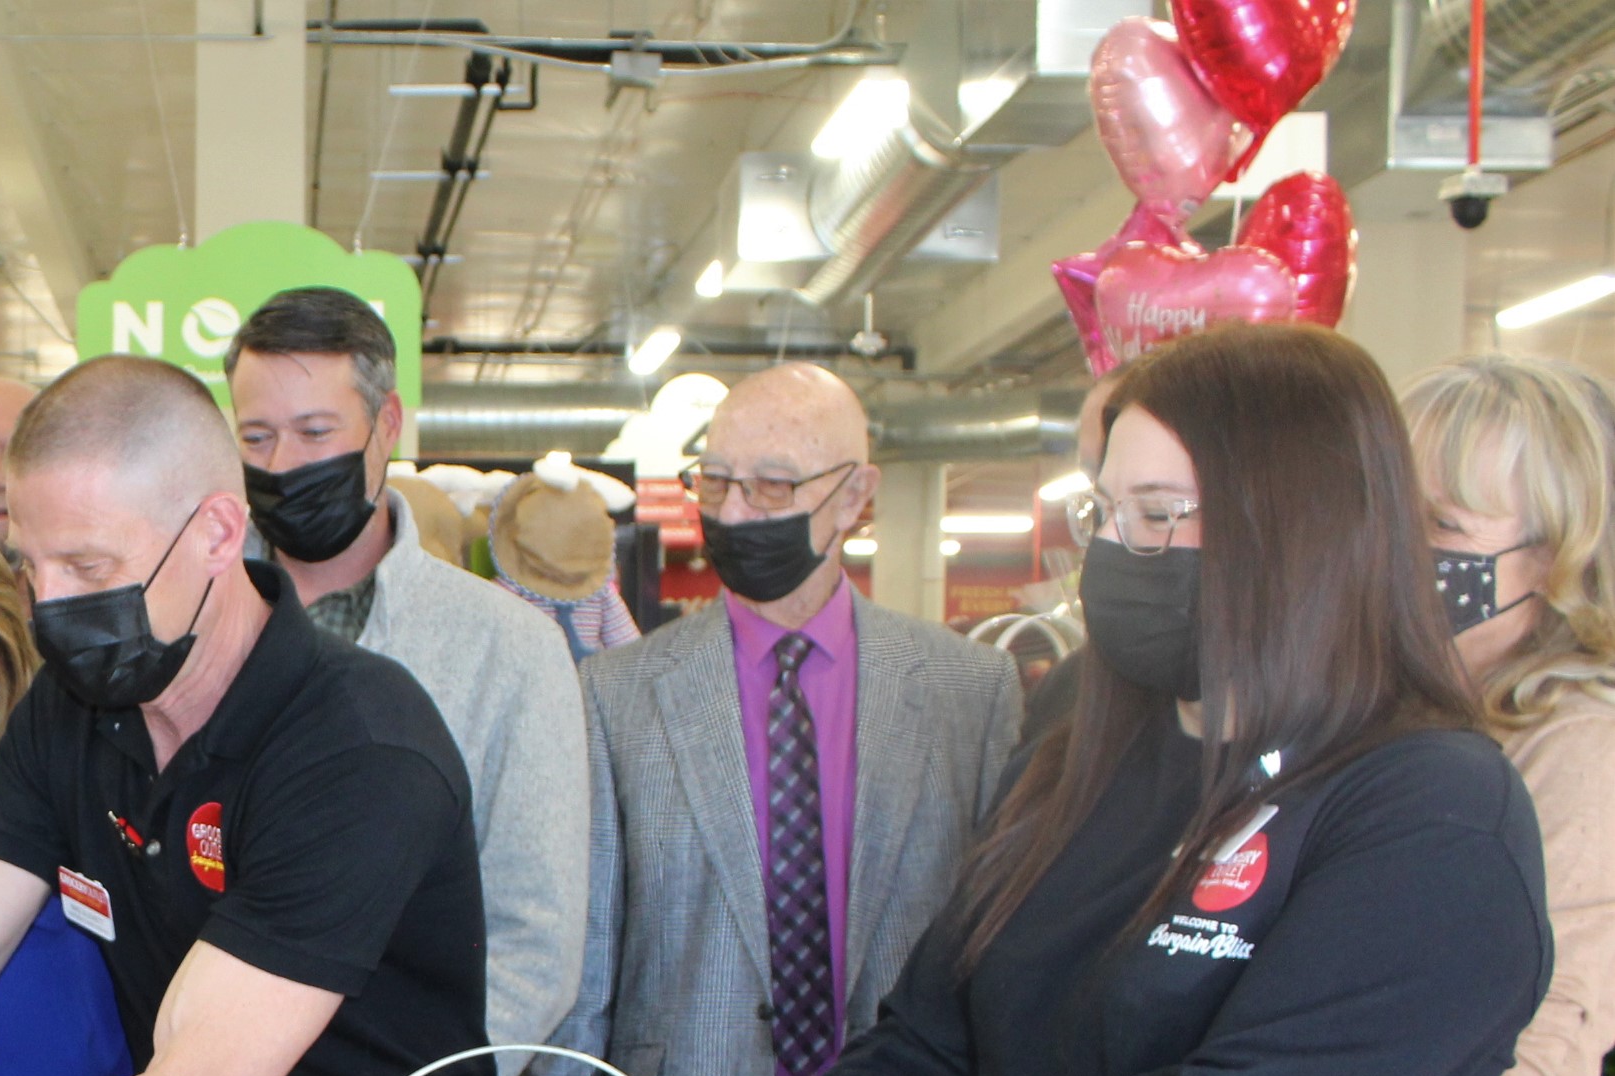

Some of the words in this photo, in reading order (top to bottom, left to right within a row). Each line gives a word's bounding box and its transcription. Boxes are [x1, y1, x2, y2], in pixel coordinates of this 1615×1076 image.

[1127, 291, 1205, 335] Happy
[1147, 923, 1211, 957] Bargain
[1172, 914, 1219, 933] WELCOME
[1220, 922, 1239, 935] TO
